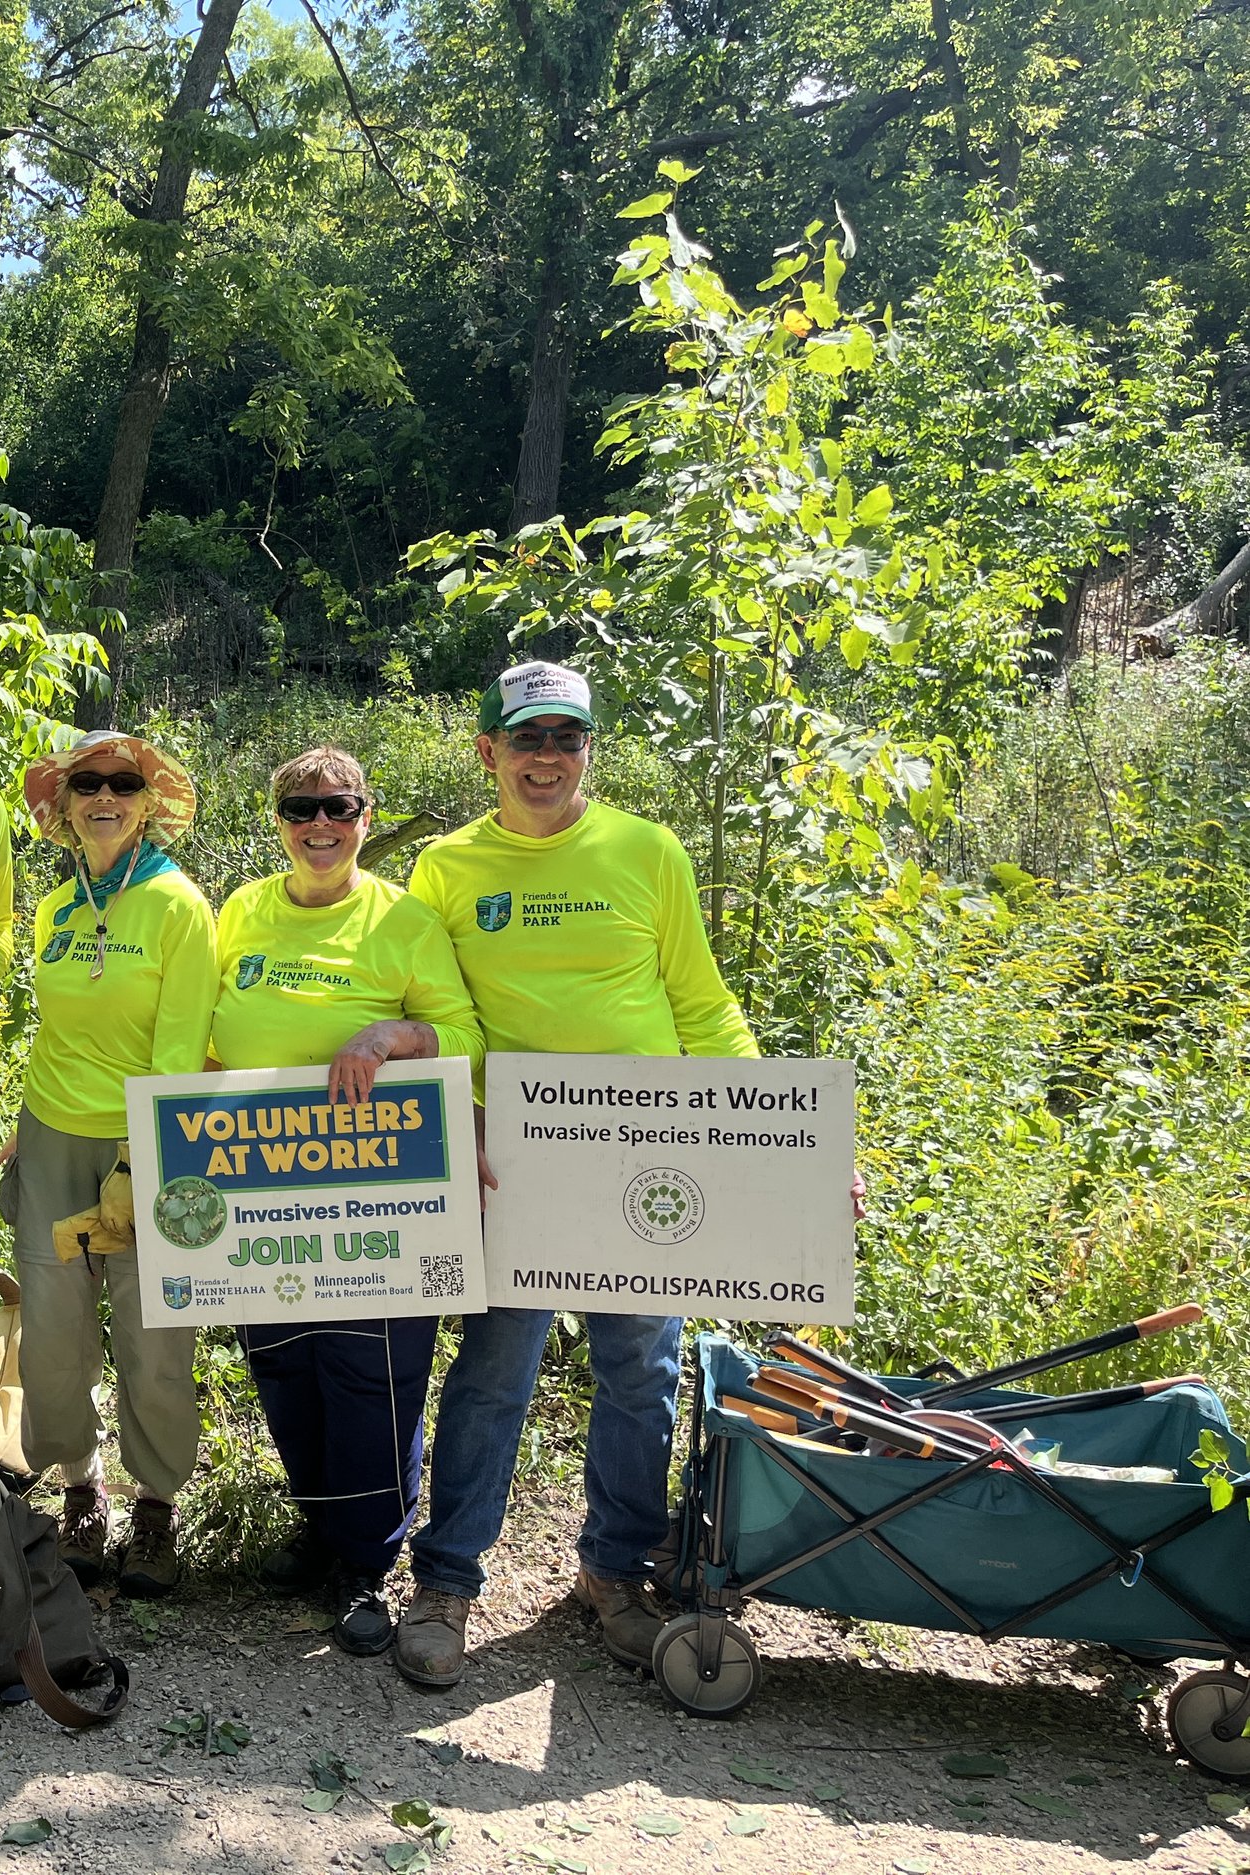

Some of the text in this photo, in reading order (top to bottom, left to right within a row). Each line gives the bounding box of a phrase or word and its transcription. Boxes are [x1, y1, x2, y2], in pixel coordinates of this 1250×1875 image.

[526, 679, 567, 690] RESORT
[522, 891, 568, 901] Friends of
[522, 901, 614, 914] MINNEHAHA
[523, 916, 561, 927] PARK
[273, 961, 313, 970] Friends of
[269, 969, 351, 986] MINNEHAHA
[520, 1080, 818, 1112] Volunteers at Work!
[176, 1098, 423, 1143] VOLUNTEERS
[523, 1121, 816, 1148] Invasive Species Removals
[205, 1136, 399, 1177] AT WORK!
[234, 1195, 446, 1224] Invasives Removal
[628, 1171, 700, 1240] Minneapolis Park & Recreation Board
[227, 1230, 400, 1267] JOIN US!
[222, 1277, 229, 1285] of
[314, 1272, 386, 1288] Minneapolis
[512, 1268, 826, 1304] MINNEAPOLISPARKS.ORG
[195, 1285, 266, 1296] MINNEHAHA
[314, 1286, 413, 1299] Park & Recreation Board
[196, 1297, 225, 1306] PARK
